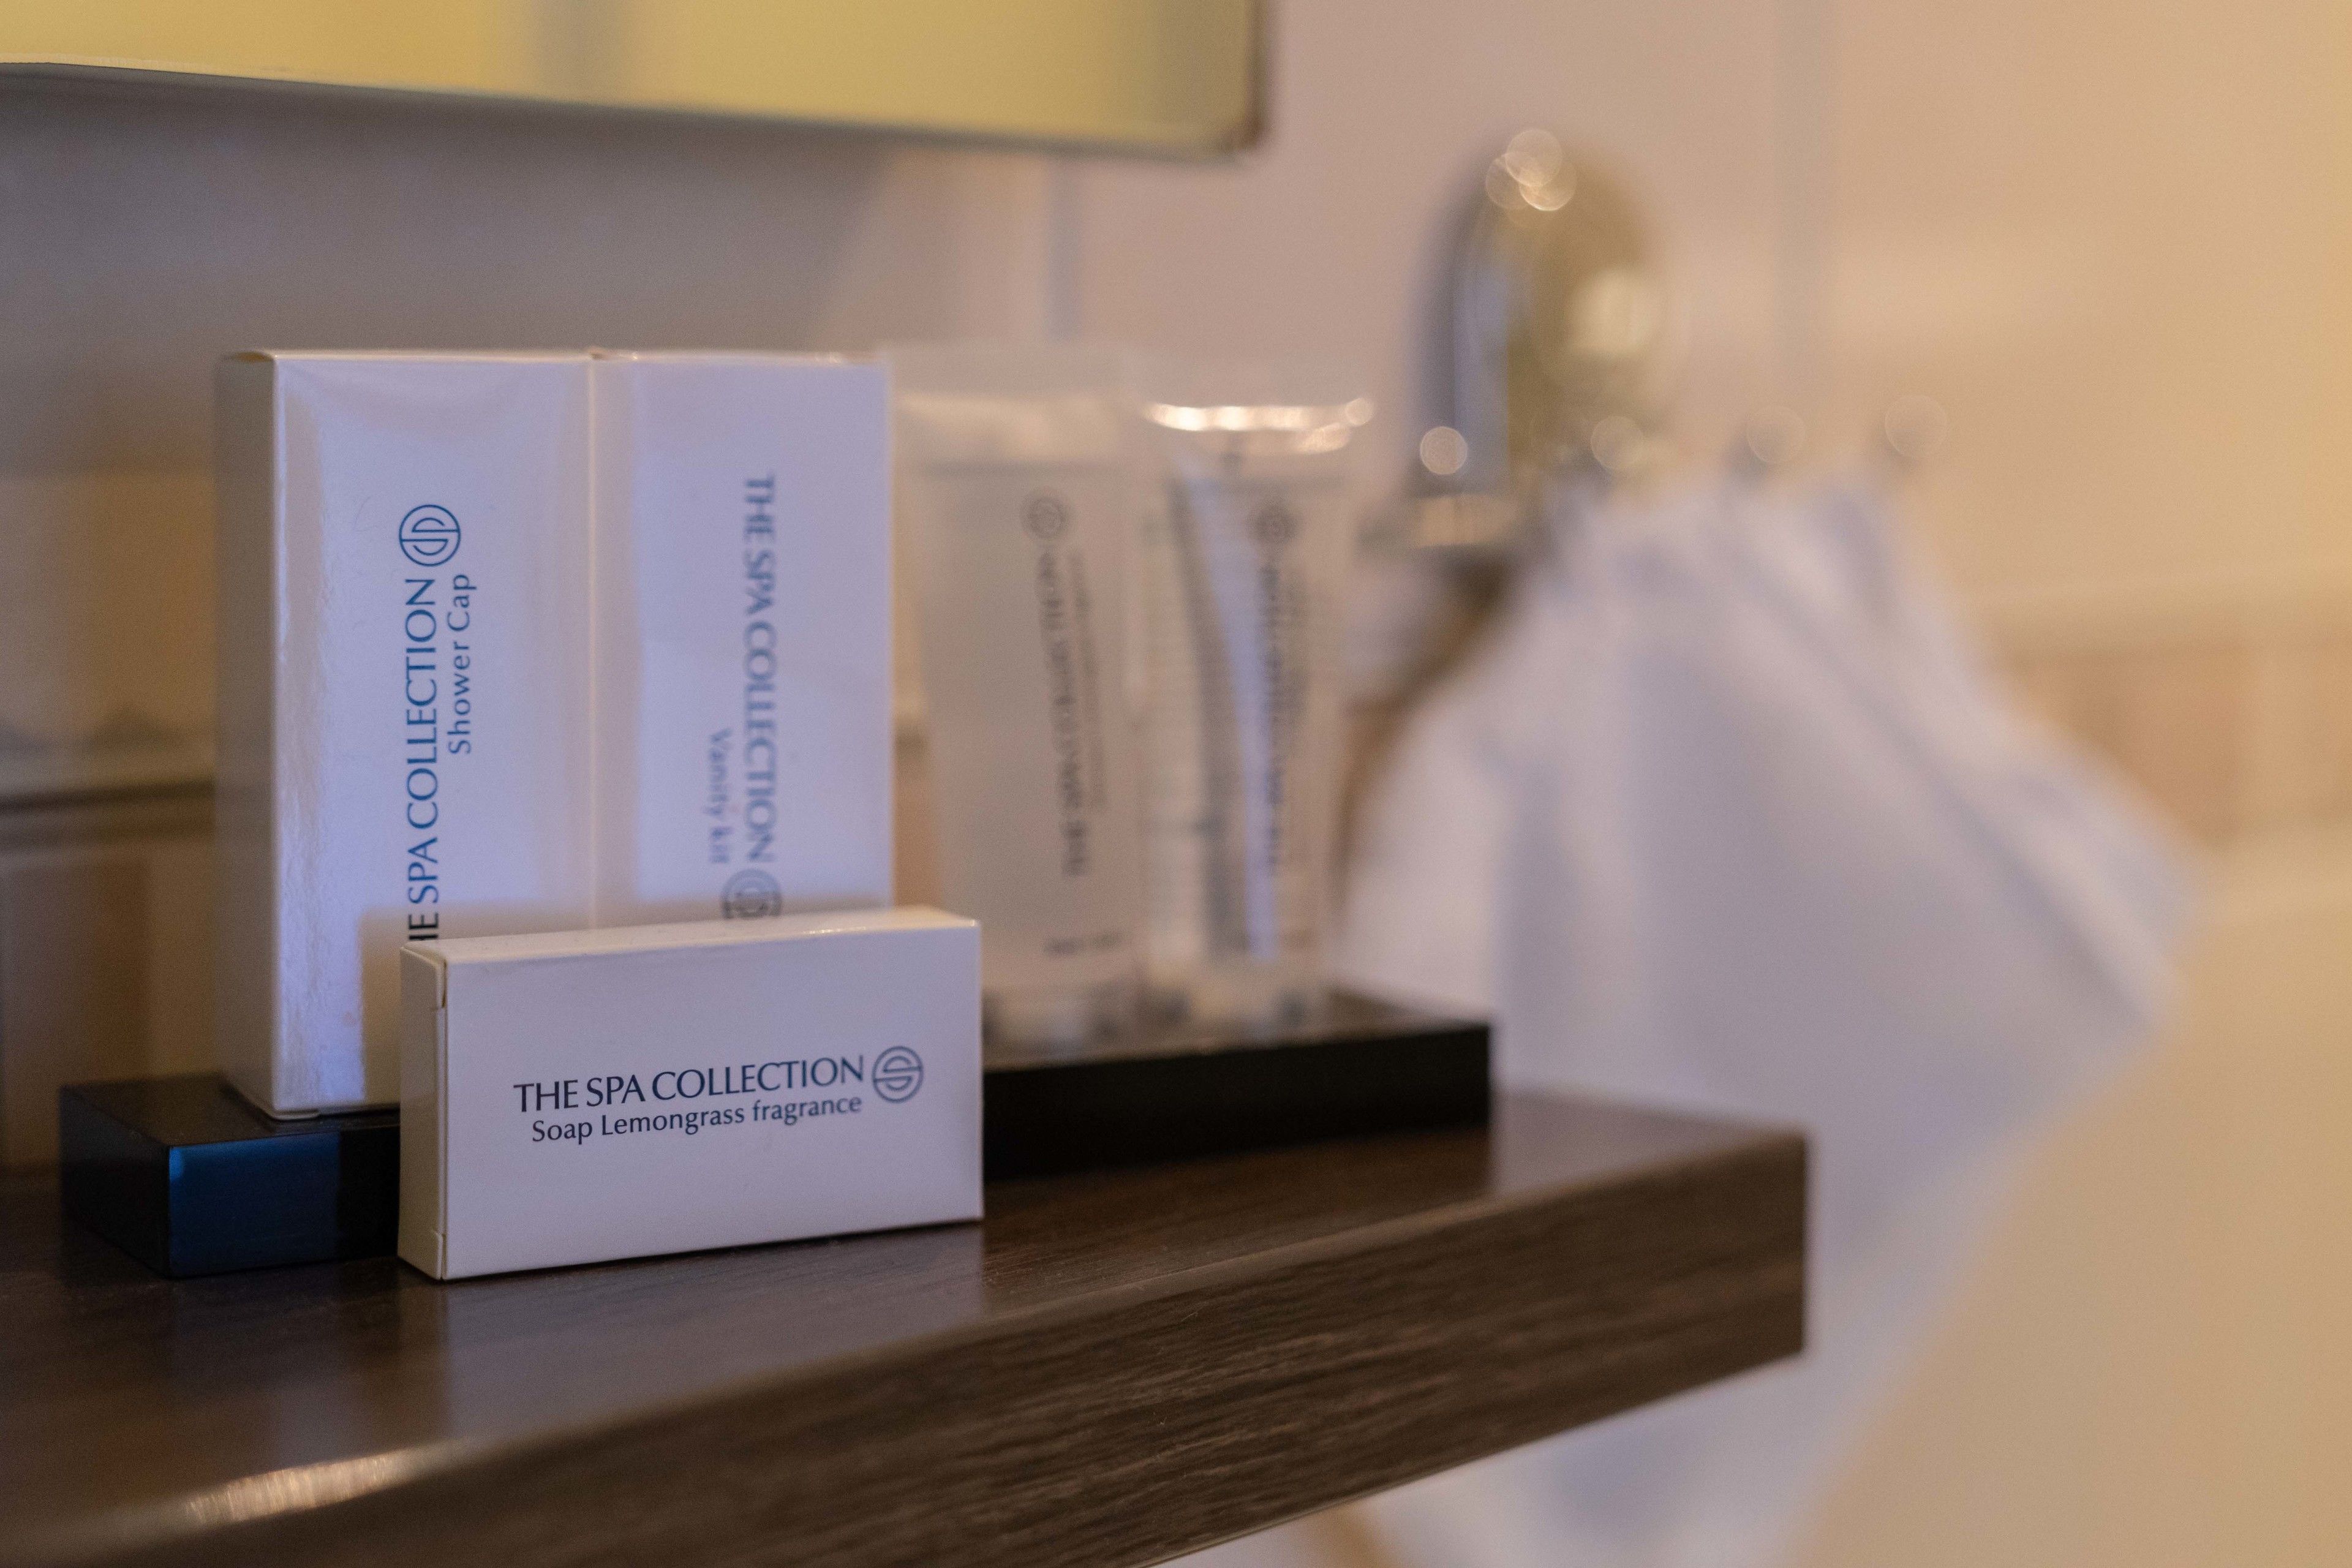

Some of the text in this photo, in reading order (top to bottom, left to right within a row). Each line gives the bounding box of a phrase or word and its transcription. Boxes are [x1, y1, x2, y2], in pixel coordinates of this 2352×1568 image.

[404, 578, 439, 831] COLLECTION
[445, 573, 478, 755] Shower Cap
[743, 473, 778, 862] THE SPA COLLECTION
[704, 727, 733, 821] Vanity
[406, 835, 439, 905] SPA
[513, 1054, 864, 1114] THE SPA COLLECTION
[531, 1096, 863, 1146] Soap Lemongrass fragrance
